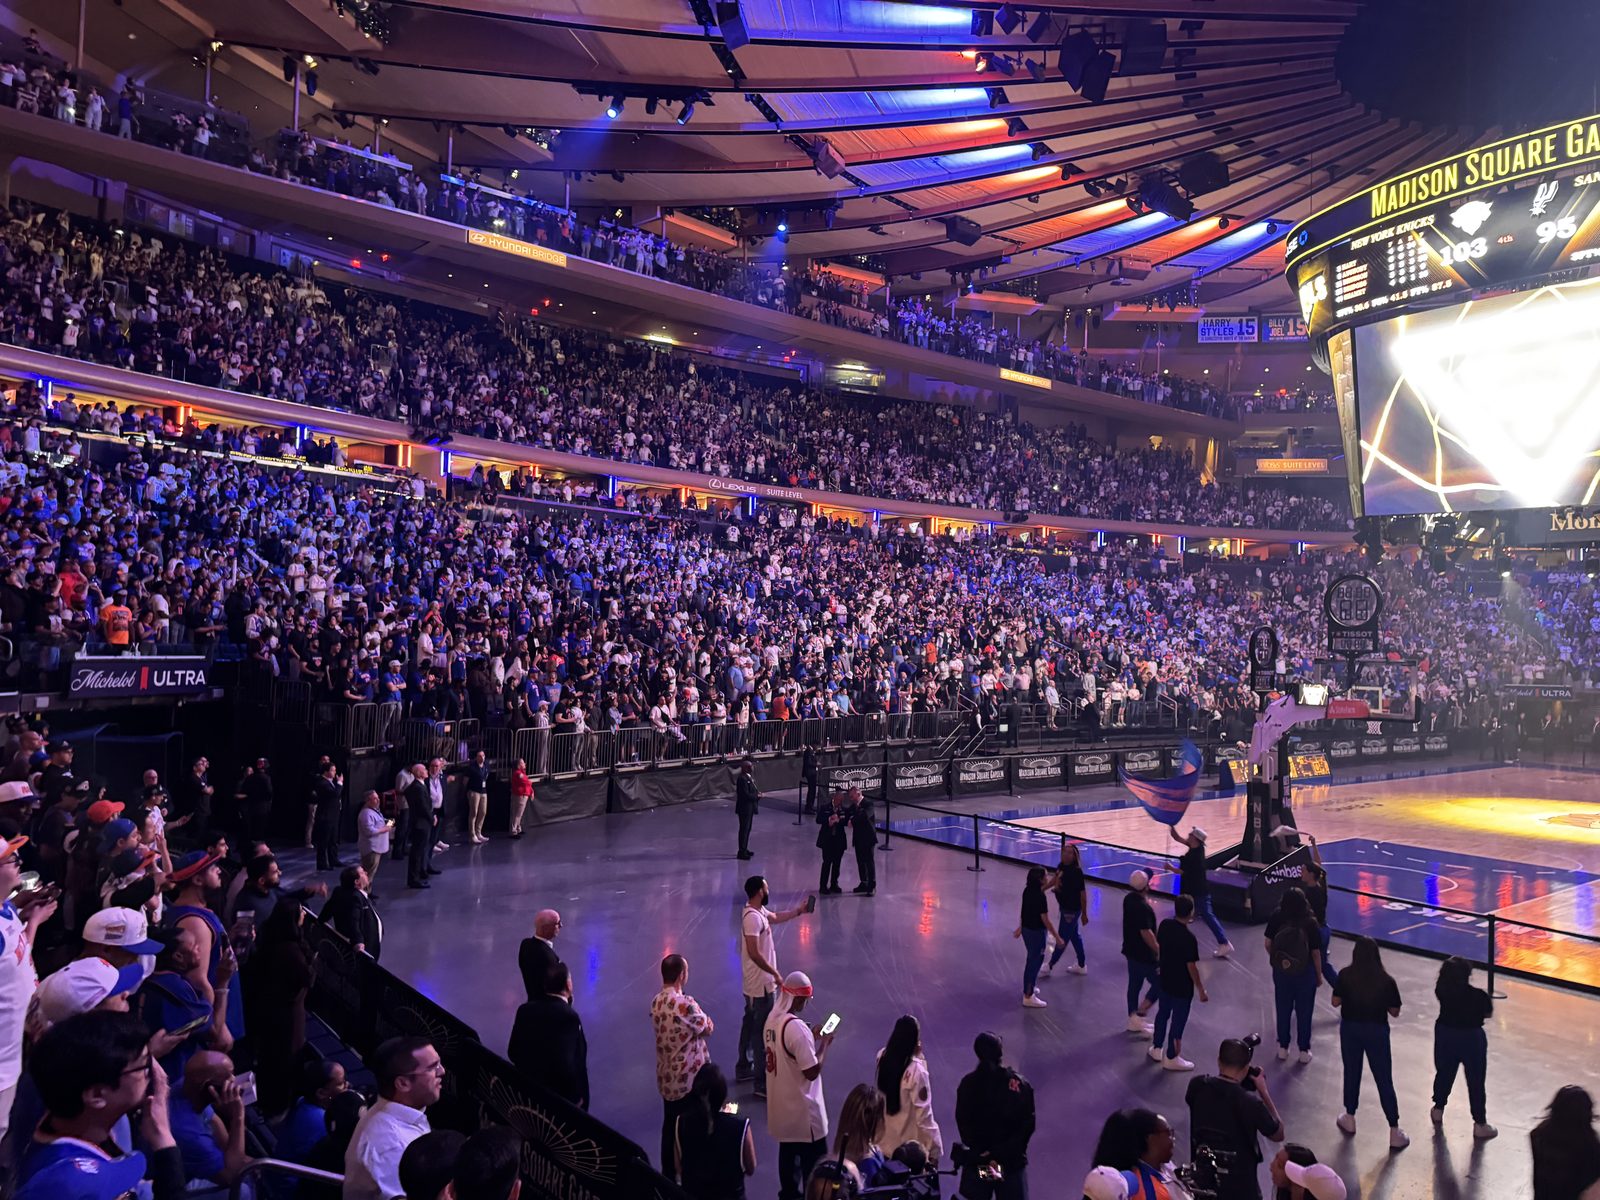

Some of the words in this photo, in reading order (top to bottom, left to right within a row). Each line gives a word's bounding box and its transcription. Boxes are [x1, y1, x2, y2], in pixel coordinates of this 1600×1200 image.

[1371, 162, 1459, 219] MADISON
[1465, 133, 1557, 186] SQUARE
[1370, 226, 1396, 243] YORK
[1396, 214, 1435, 235] KNICKS
[1536, 216, 1577, 244] 95
[1497, 234, 1514, 244] 4th
[488, 237, 531, 255] HYUNDAI
[533, 248, 565, 264] BRIDGE
[1439, 237, 1488, 267] 103
[1200, 327, 1234, 337] STYLES
[1203, 319, 1231, 328] HARRY
[1237, 318, 1256, 336] 15
[1268, 319, 1285, 328] BILLY
[1269, 327, 1284, 337] JOEL
[1287, 318, 1307, 337] 15
[1283, 461, 1301, 469] SUITE
[1304, 461, 1325, 469] LEVEL
[722, 482, 757, 493] LEXUS
[766, 488, 785, 497] SUITE
[785, 490, 803, 499] LEVEL
[71, 669, 137, 691] Michelob
[153, 670, 206, 687] ULTRA
[1541, 689, 1572, 697] ULTRA
[895, 778, 913, 788] MADISON
[913, 776, 928, 786] SQUARE
[928, 774, 943, 784] GARDEN
[1253, 801, 1262, 844] NBA
